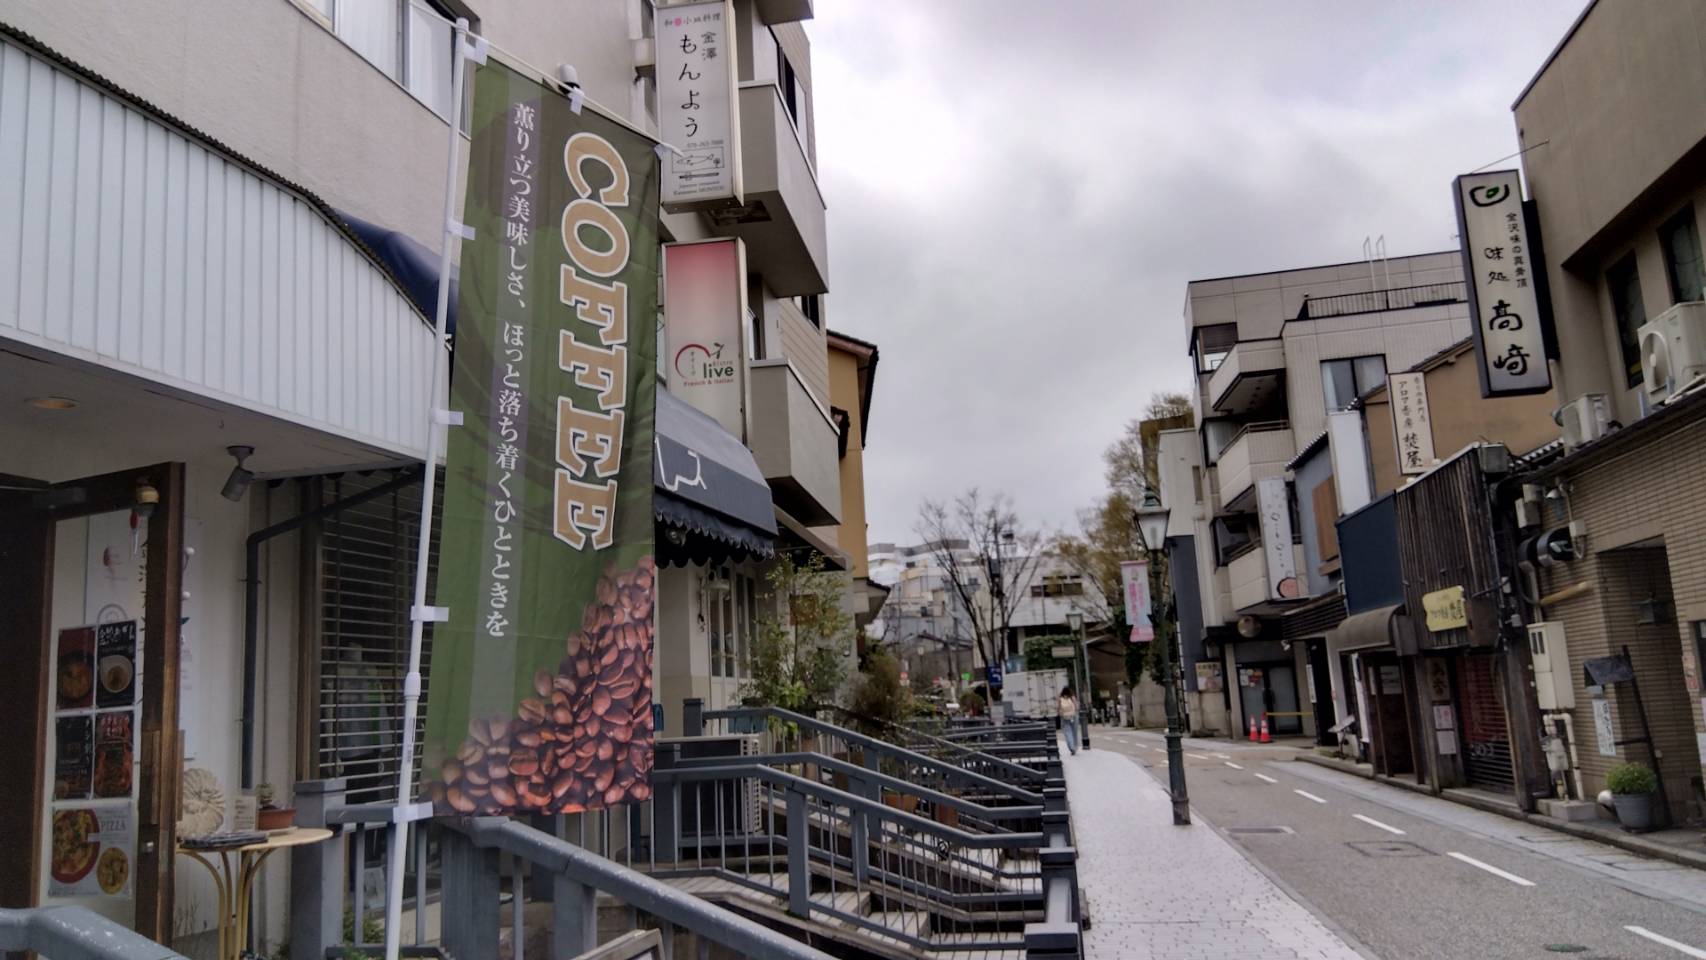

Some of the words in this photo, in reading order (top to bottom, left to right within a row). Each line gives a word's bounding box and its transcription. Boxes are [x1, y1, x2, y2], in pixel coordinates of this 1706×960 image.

[678, 33, 701, 138] もんよう
[553, 131, 630, 550] COFFEE
